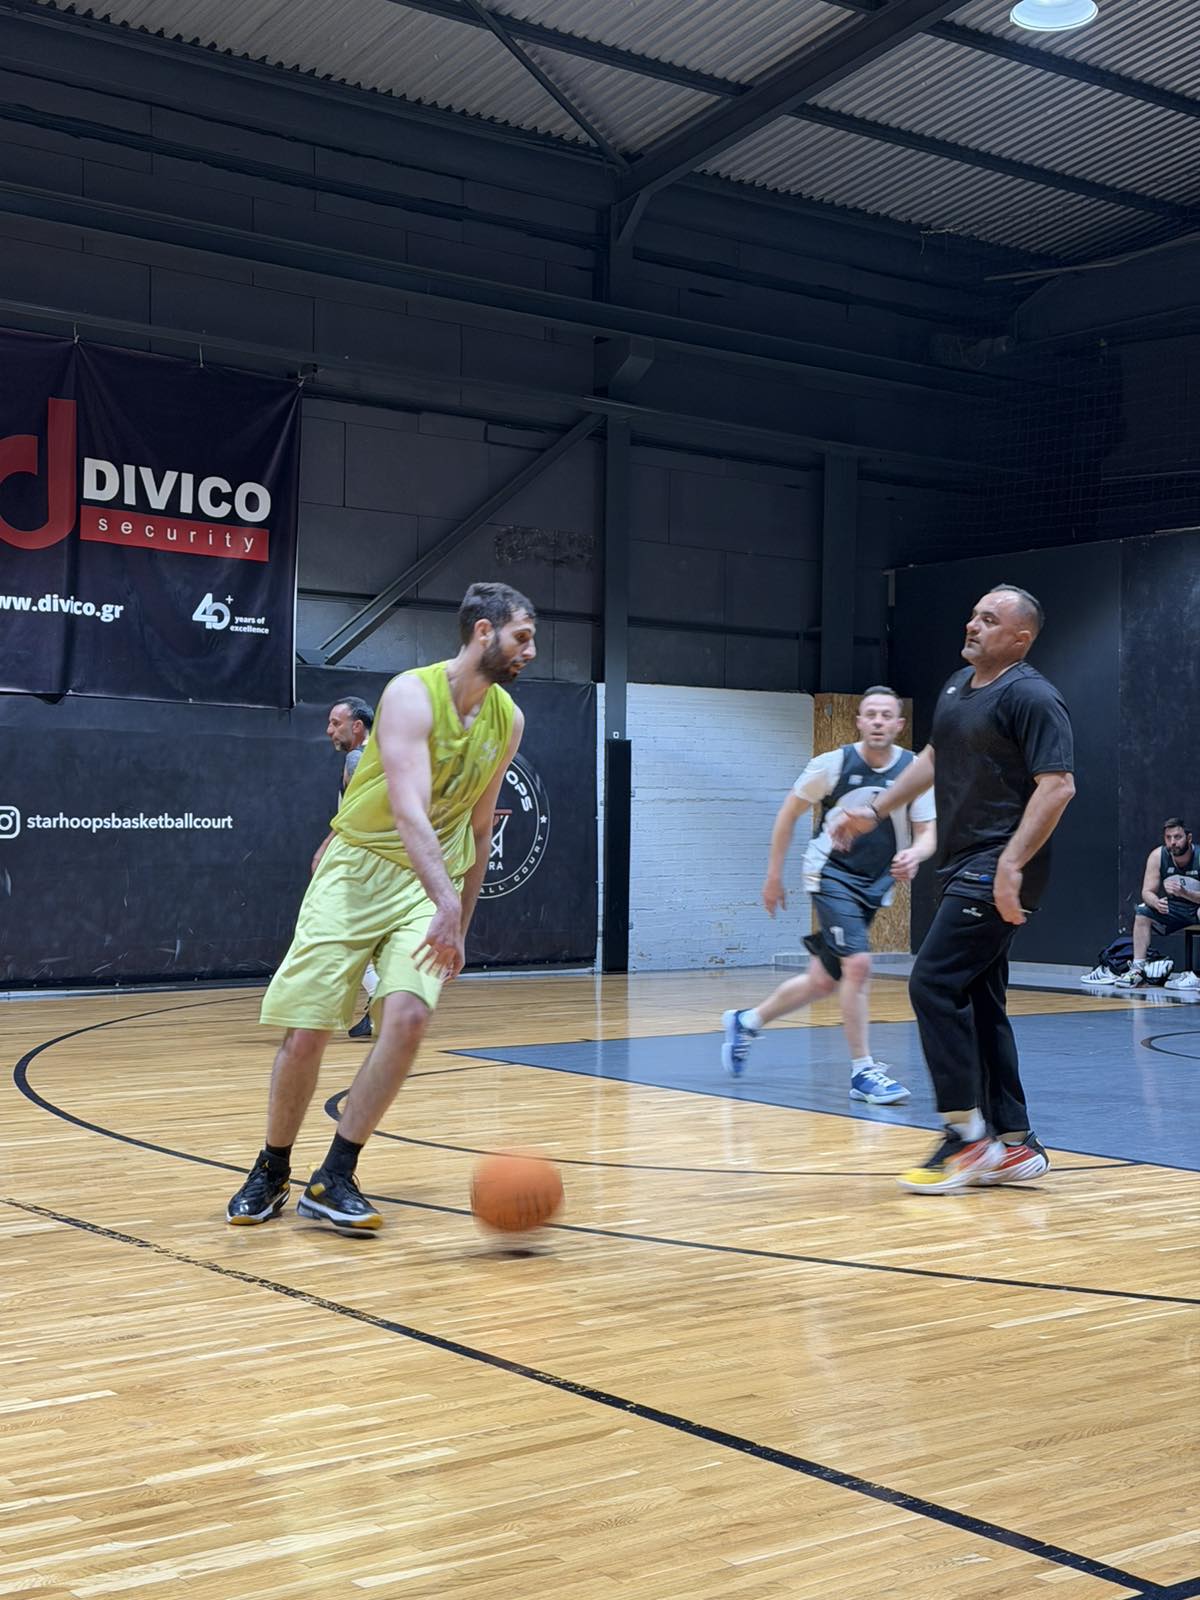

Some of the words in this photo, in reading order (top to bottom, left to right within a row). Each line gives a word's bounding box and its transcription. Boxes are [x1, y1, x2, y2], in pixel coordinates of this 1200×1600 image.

[83, 457, 272, 522] DIVICO
[98, 517, 254, 553] security
[229, 625, 269, 634] excellence
[234, 616, 256, 624] years
[505, 770, 533, 812] OPS
[26, 812, 233, 833] starhoopsbasketballcourt
[514, 835, 544, 882] COURT
